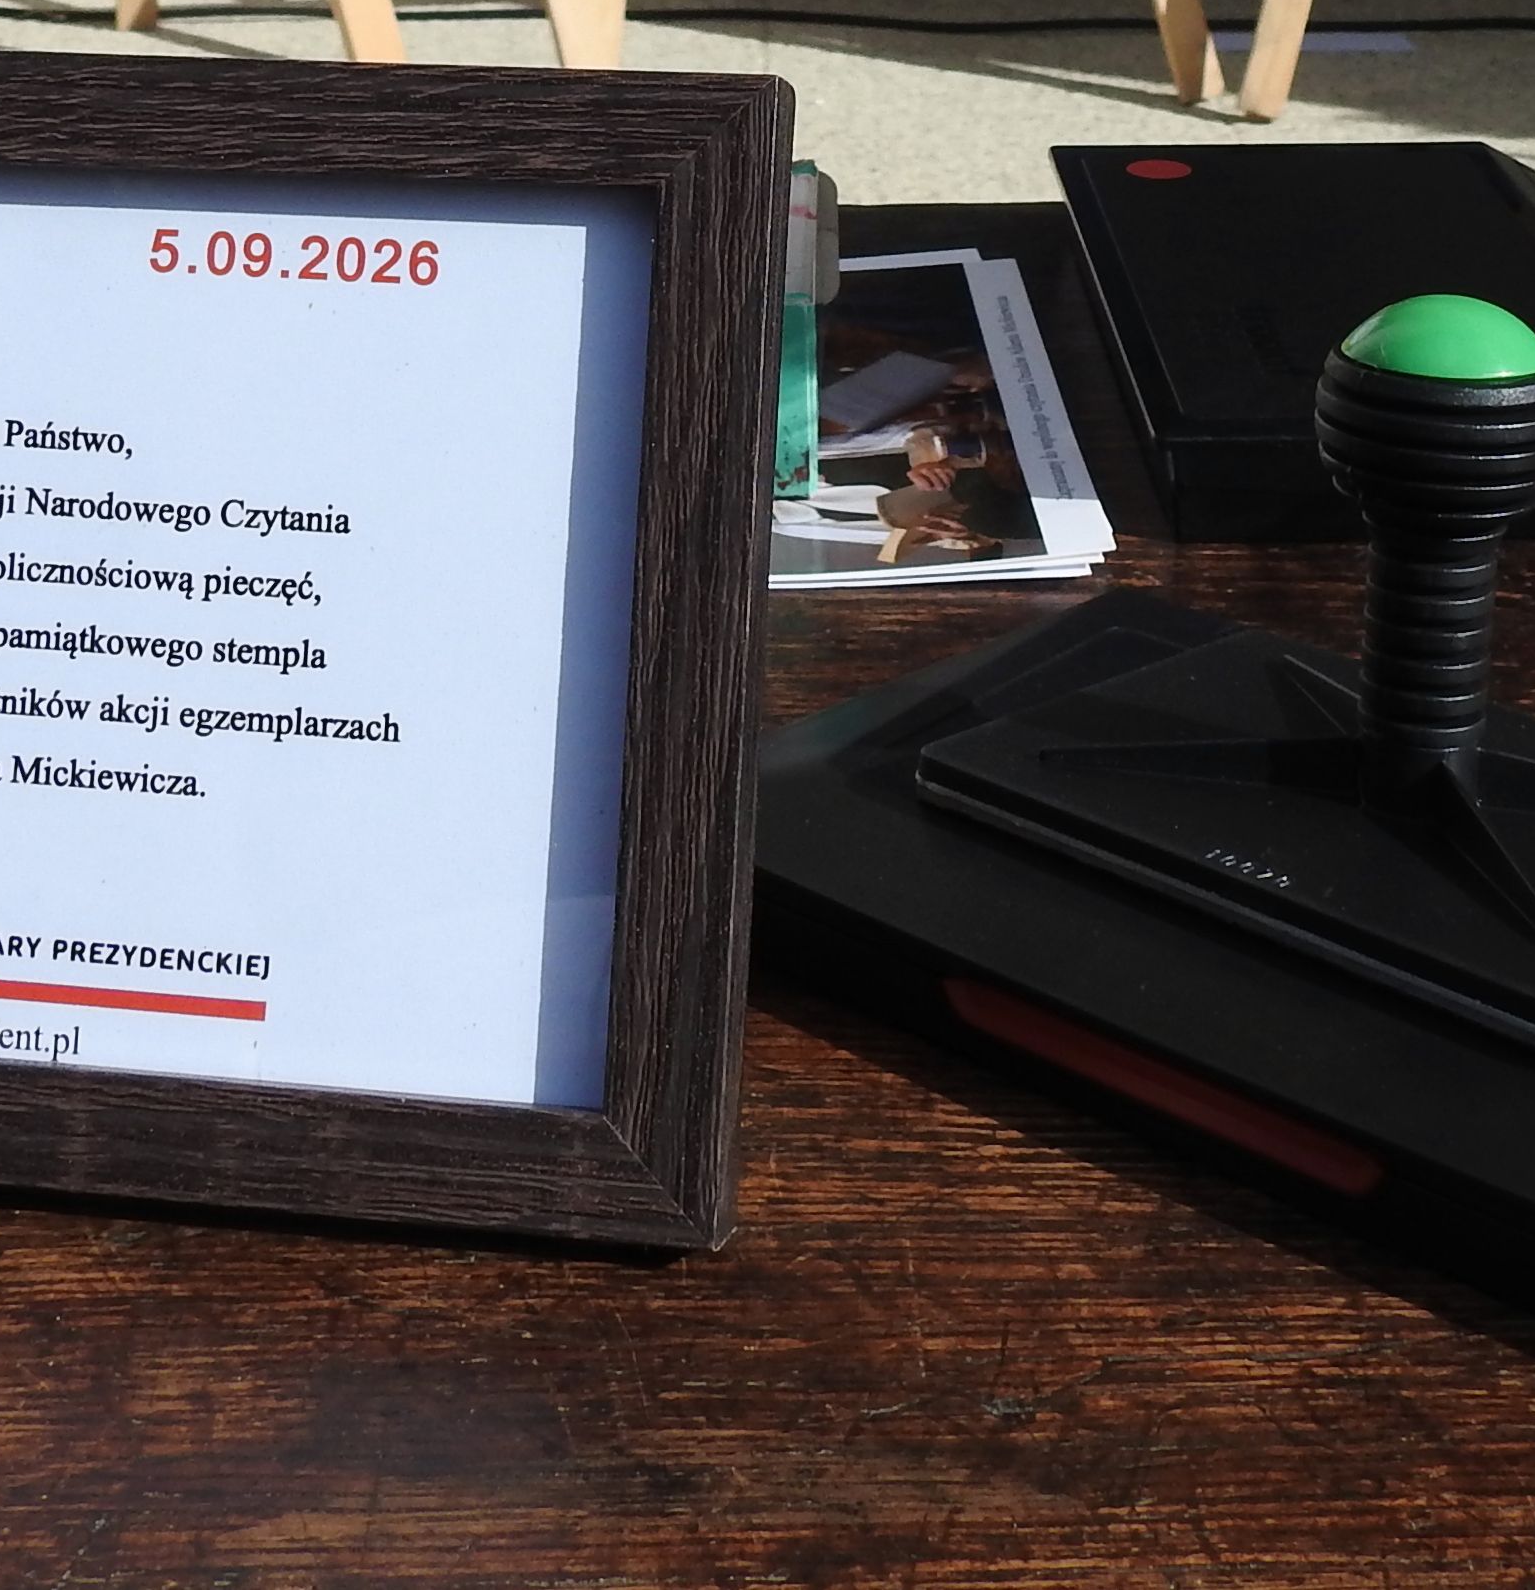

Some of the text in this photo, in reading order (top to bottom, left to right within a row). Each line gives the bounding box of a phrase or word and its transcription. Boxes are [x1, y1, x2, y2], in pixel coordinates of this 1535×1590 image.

[150, 229, 438, 285] 5.09.2026
[4, 420, 132, 460] Państwo,
[25, 487, 211, 532] Narodowego
[221, 499, 351, 537] Czytania
[201, 566, 321, 606] pieczęć,
[213, 638, 327, 675] stempla
[100, 694, 169, 733] akcji
[180, 707, 400, 742] egzemplarzach
[10, 755, 205, 797] Mickiewicza.
[53, 939, 270, 980] PREZYDENCKIEJ
